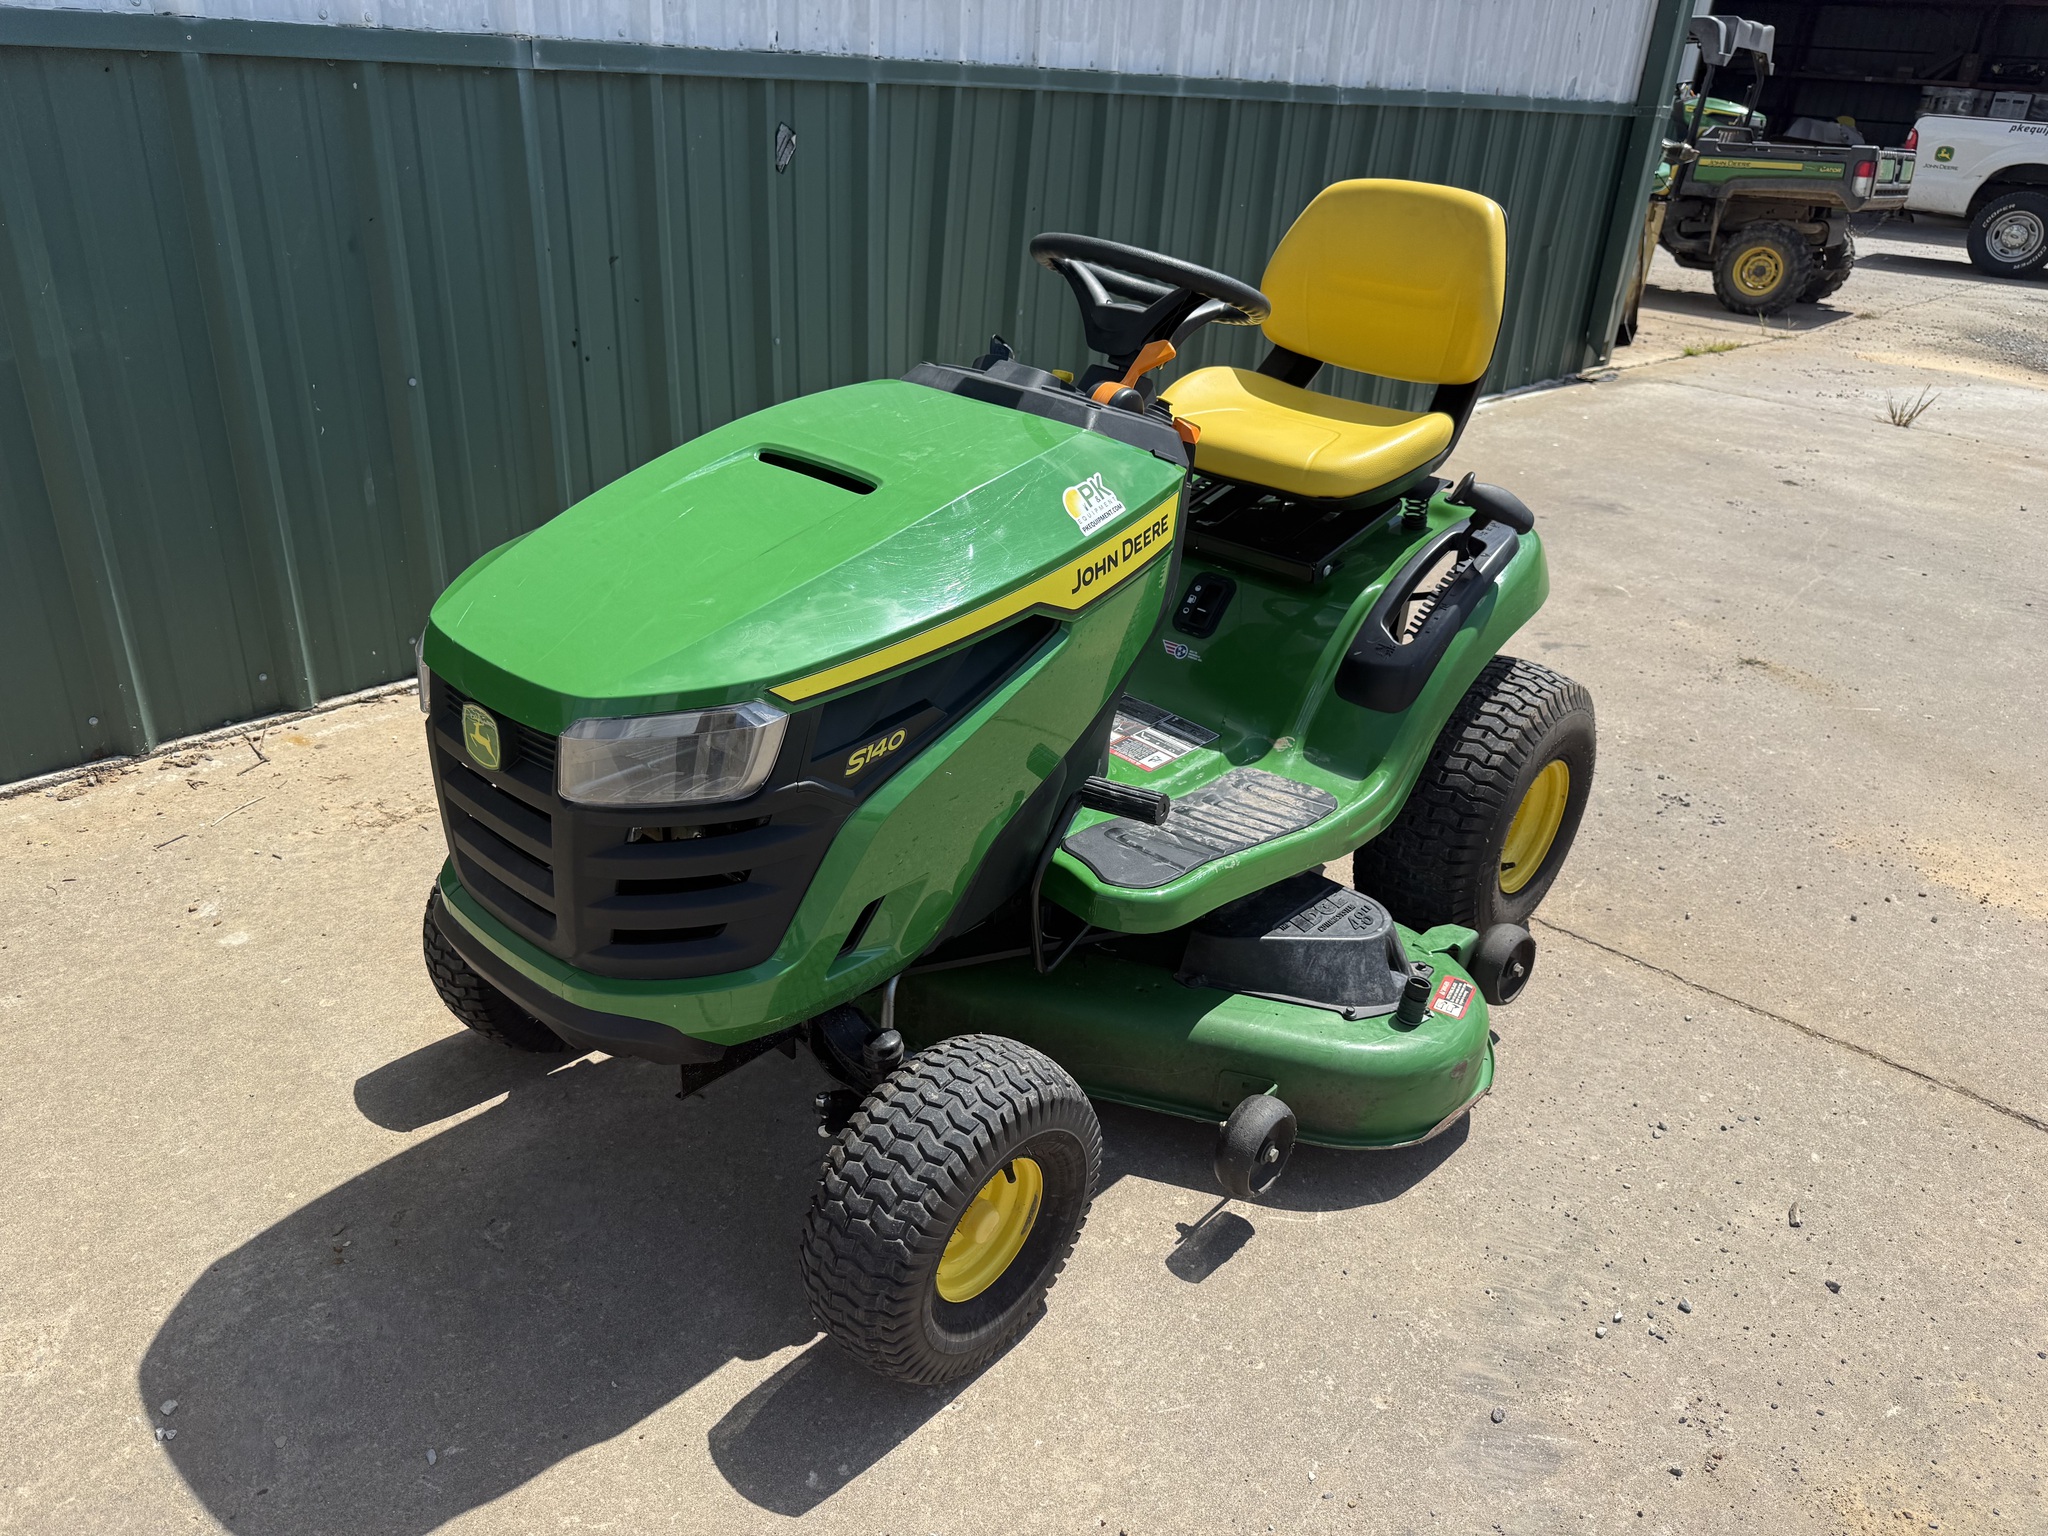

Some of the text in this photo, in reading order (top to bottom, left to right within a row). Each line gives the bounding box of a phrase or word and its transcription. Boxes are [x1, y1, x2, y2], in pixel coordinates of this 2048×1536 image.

[1709, 160, 1751, 168] JOHN DEERE
[1982, 203, 2015, 228] COOPER
[2013, 245, 2047, 269] COOPER
[1078, 496, 1116, 525] EQUIPMENT
[1081, 502, 1123, 534] PKEQUIPMENT.COM
[1071, 513, 1169, 595] JOHN DEERE
[845, 729, 906, 776] S140
